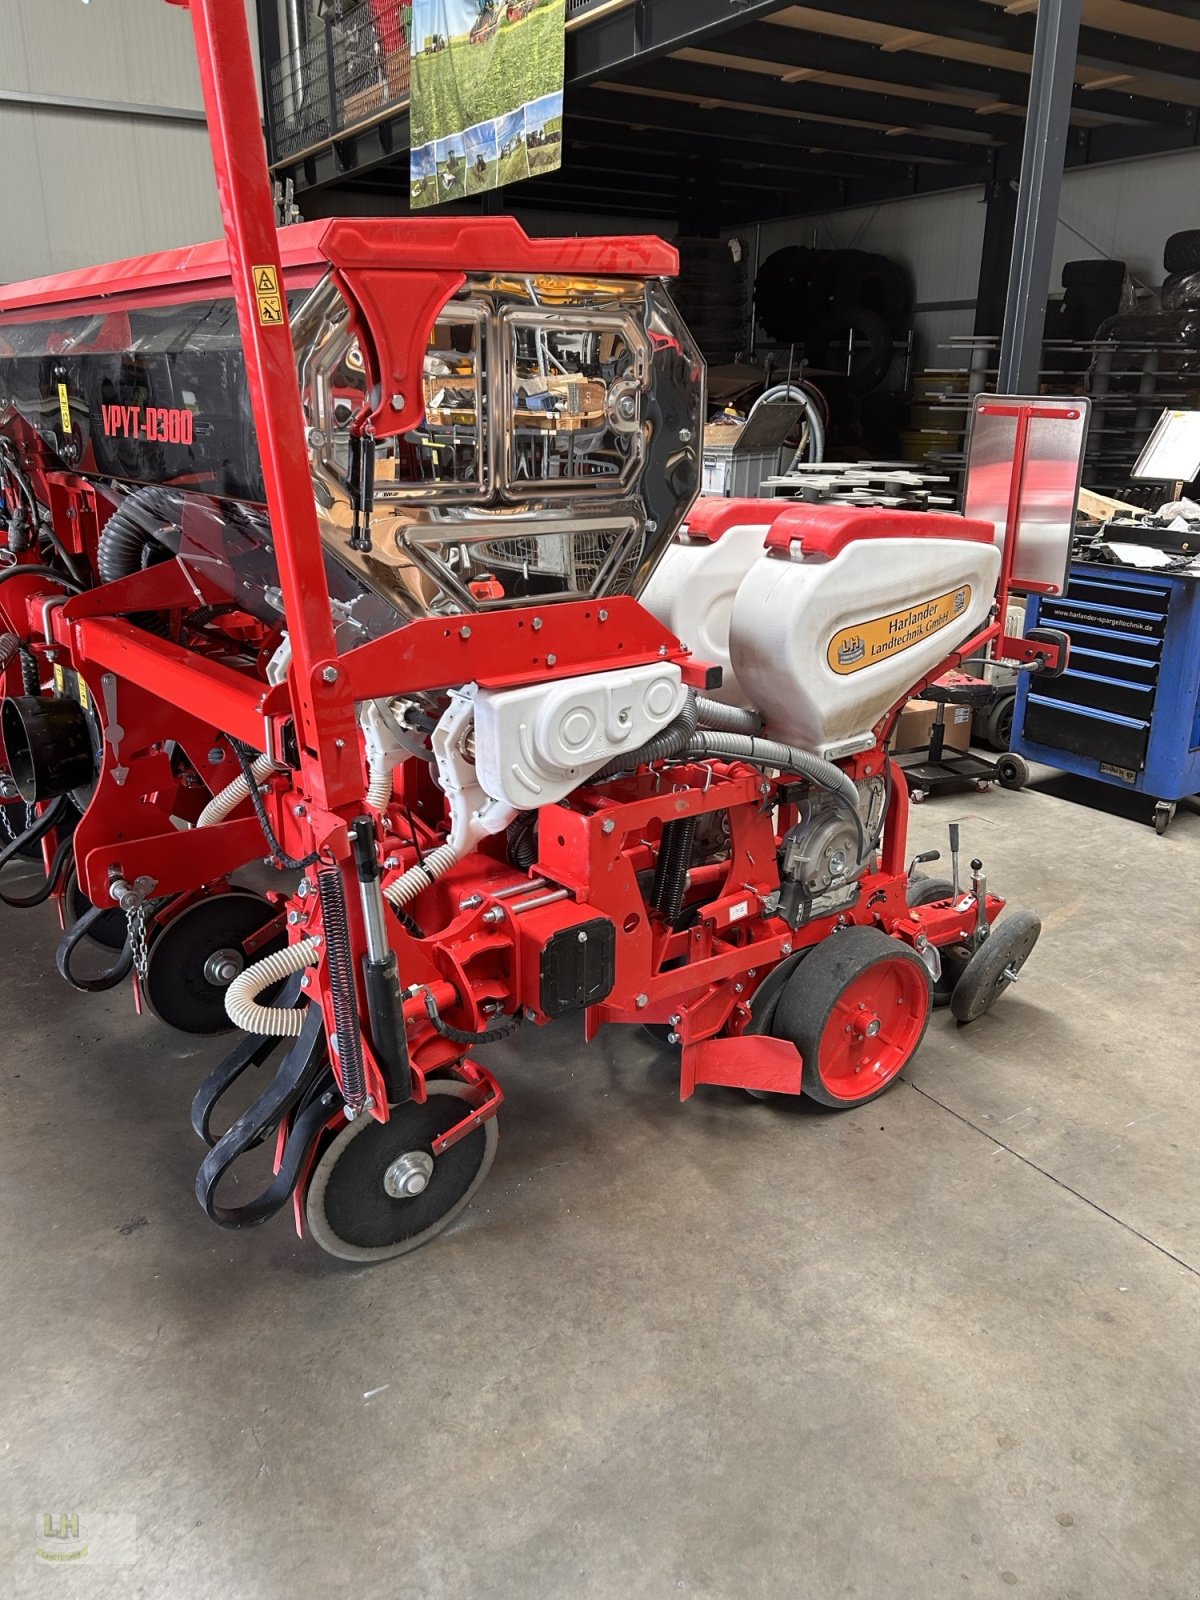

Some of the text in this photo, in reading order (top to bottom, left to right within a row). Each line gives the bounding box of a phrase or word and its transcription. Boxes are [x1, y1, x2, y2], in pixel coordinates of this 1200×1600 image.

[102, 405, 193, 445] VPYT-D300
[871, 611, 949, 656] Landtechnik GmbH
[889, 604, 938, 634] Harlander
[1054, 609, 1153, 632] www.harlander-spargeltechnik.de
[842, 635, 860, 653] LH
